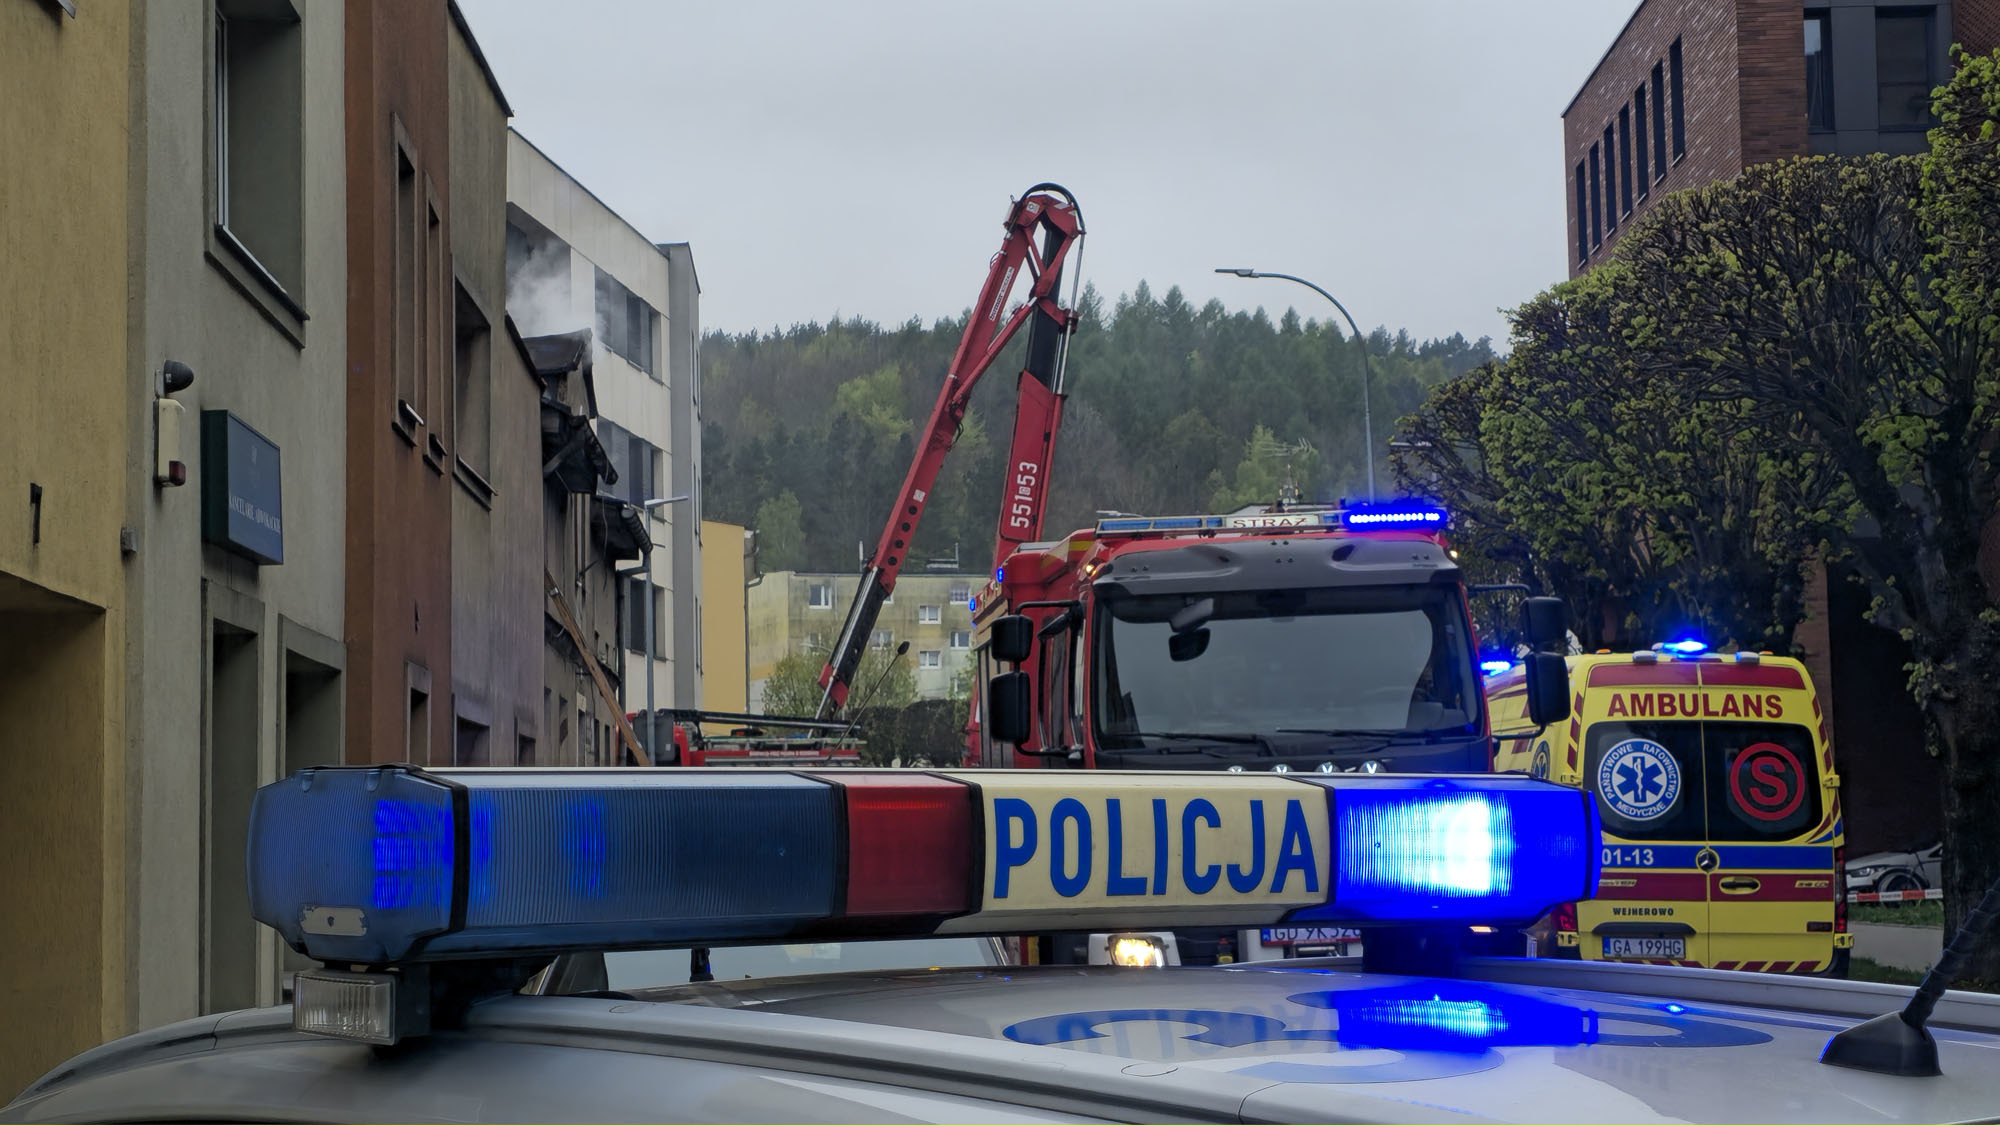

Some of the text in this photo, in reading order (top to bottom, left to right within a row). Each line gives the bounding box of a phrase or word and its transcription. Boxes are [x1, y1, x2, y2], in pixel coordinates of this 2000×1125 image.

[1607, 693, 1783, 718] AMBULANS
[1601, 744, 1677, 799] PAŃSTWOWE RATOWNICTWO
[1750, 756, 1788, 806] S
[1616, 801, 1666, 816] MEDYCZNE
[993, 797, 1319, 898] POLICJA
[1602, 848, 1654, 865] 01-13
[1613, 907, 1674, 916] WEJHEROWO
[1613, 939, 1682, 956] GA 199HG
